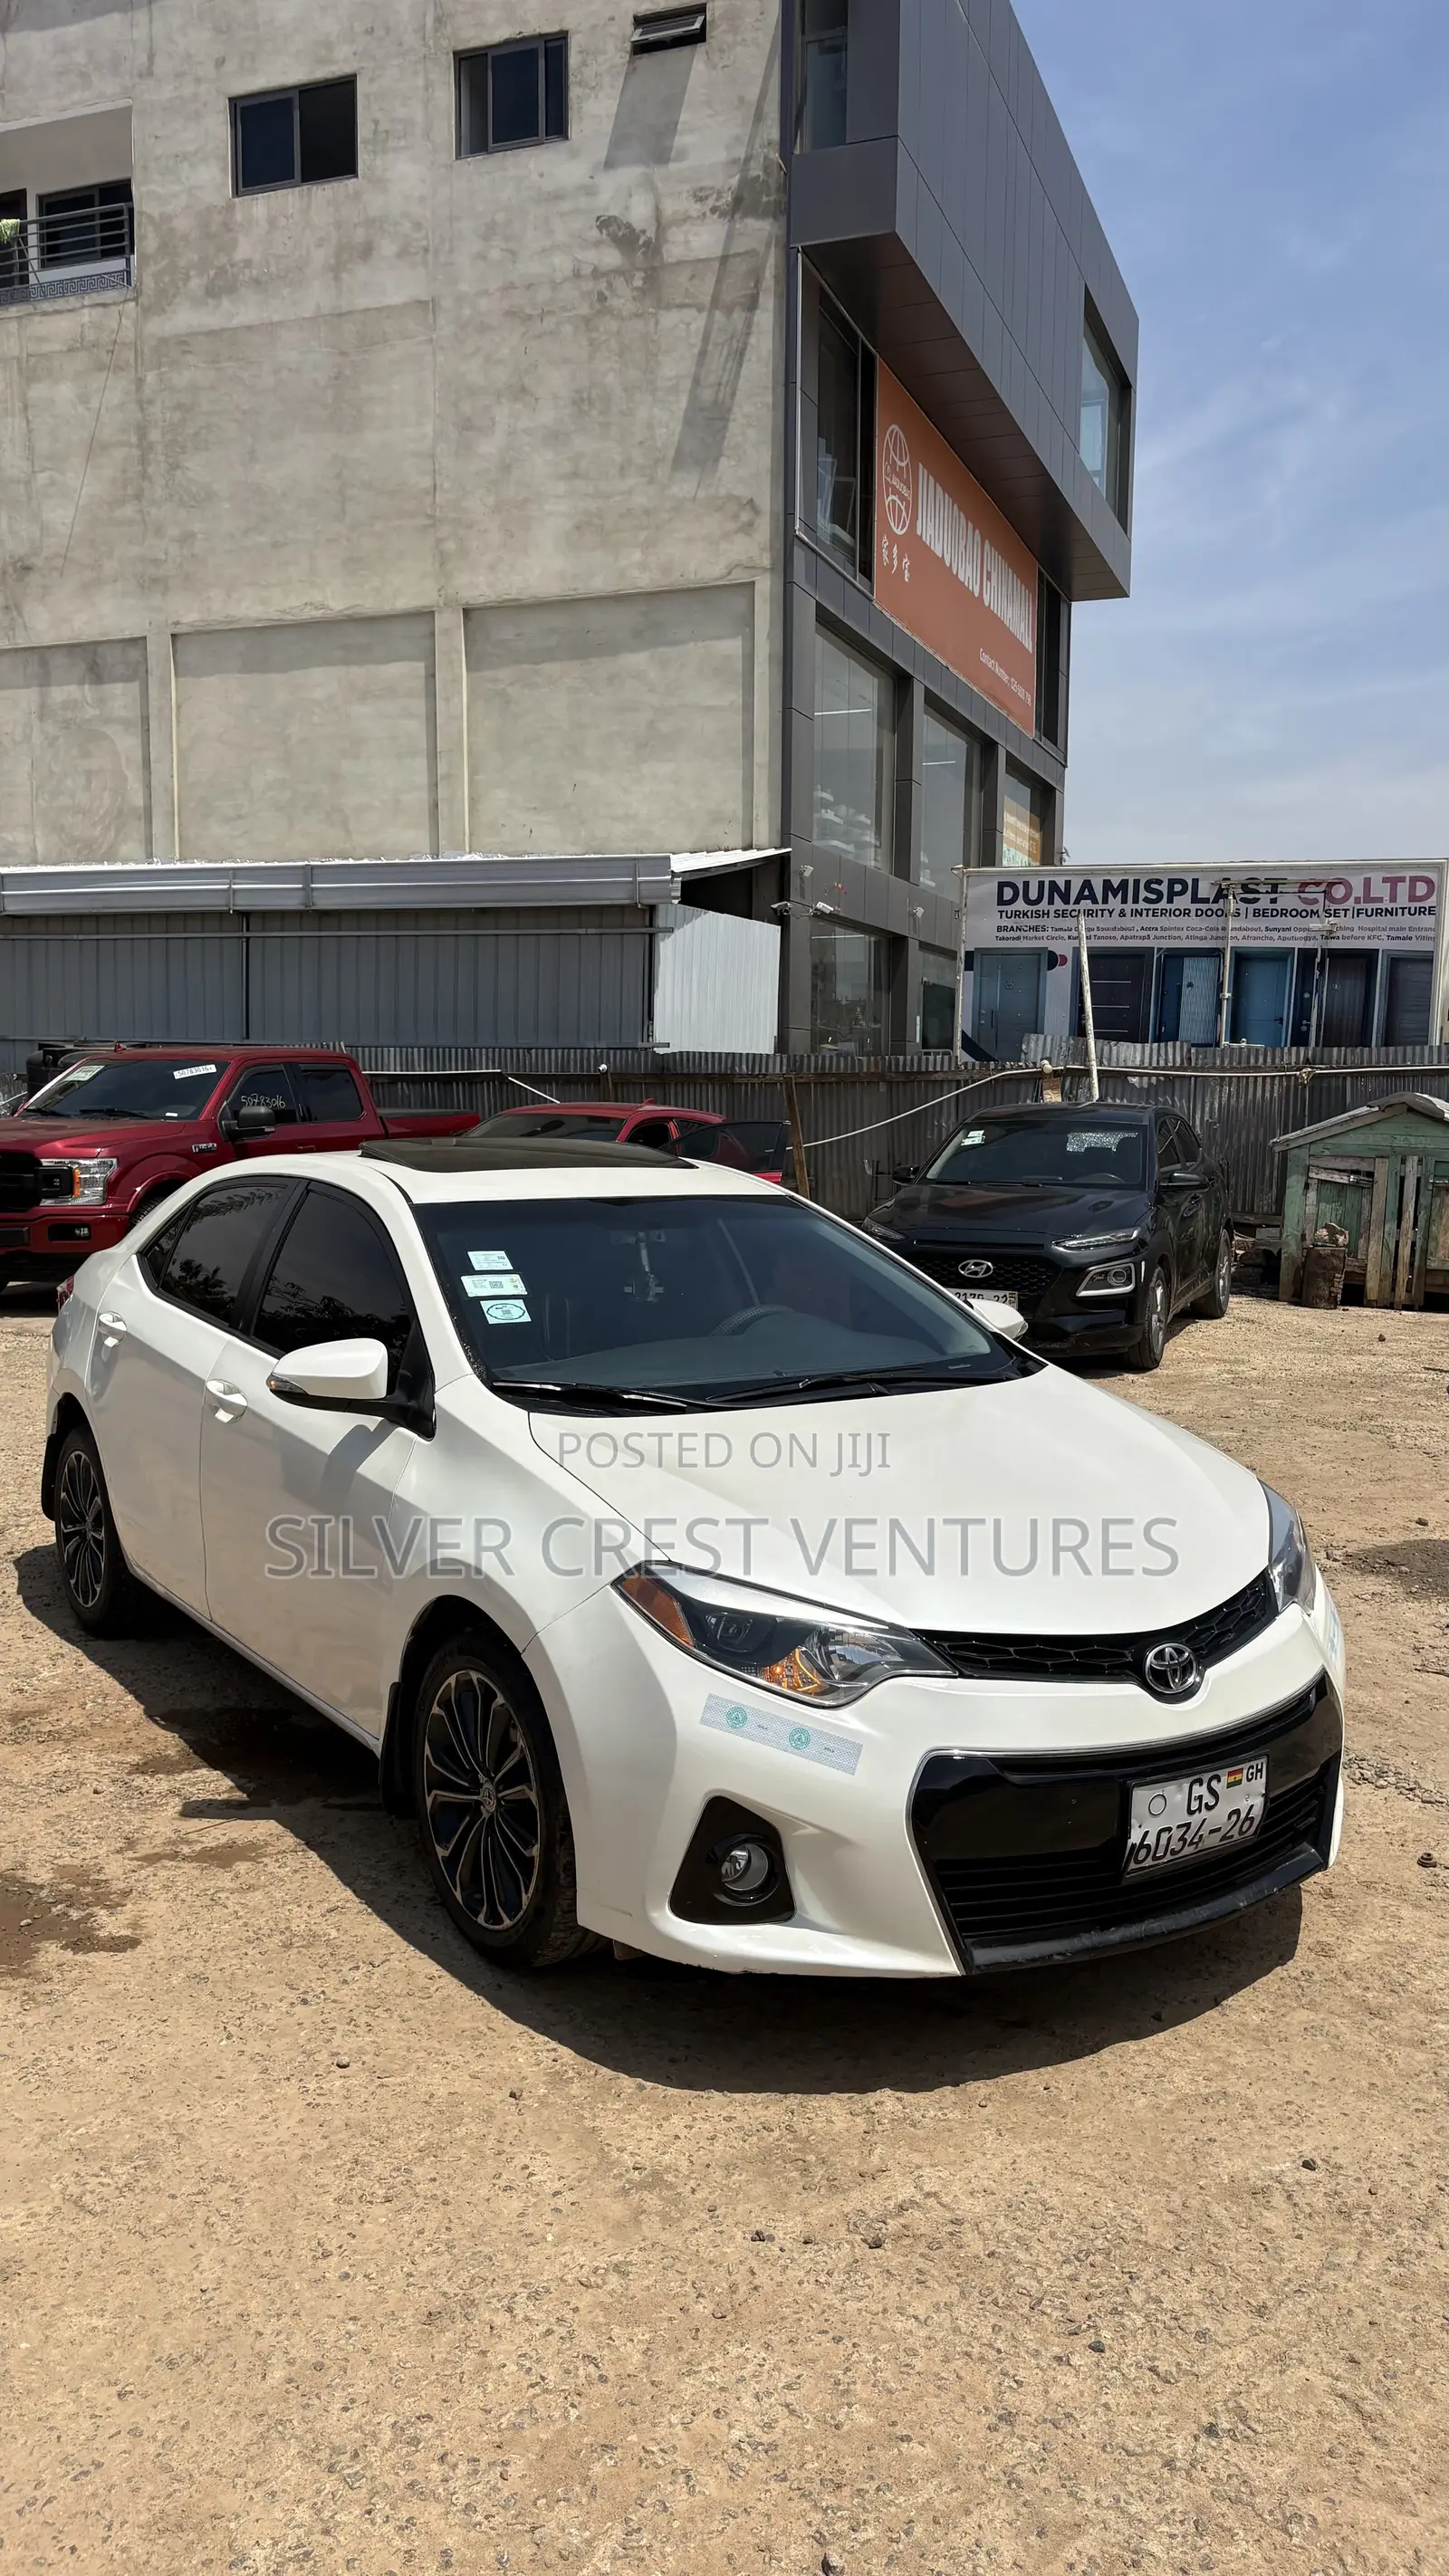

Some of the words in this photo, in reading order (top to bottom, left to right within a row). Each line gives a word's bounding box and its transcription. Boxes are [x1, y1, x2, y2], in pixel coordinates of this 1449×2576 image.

[916, 462, 982, 598] JIADUOBAO
[996, 877, 1288, 906] DUNAMISPLAST
[996, 924, 1050, 933] BRANCHES:
[1358, 924, 1387, 934] Hospital
[997, 909, 1051, 920] TURKISH
[1118, 908, 1128, 918] &
[1130, 908, 1192, 918] INTERIOR
[1195, 907, 1241, 918] DOOS
[1252, 908, 1320, 918] BEDROOM
[1186, 1774, 1222, 1816] GS
[1245, 1762, 1264, 1783] GH
[1132, 1804, 1256, 1865] 6034-26
